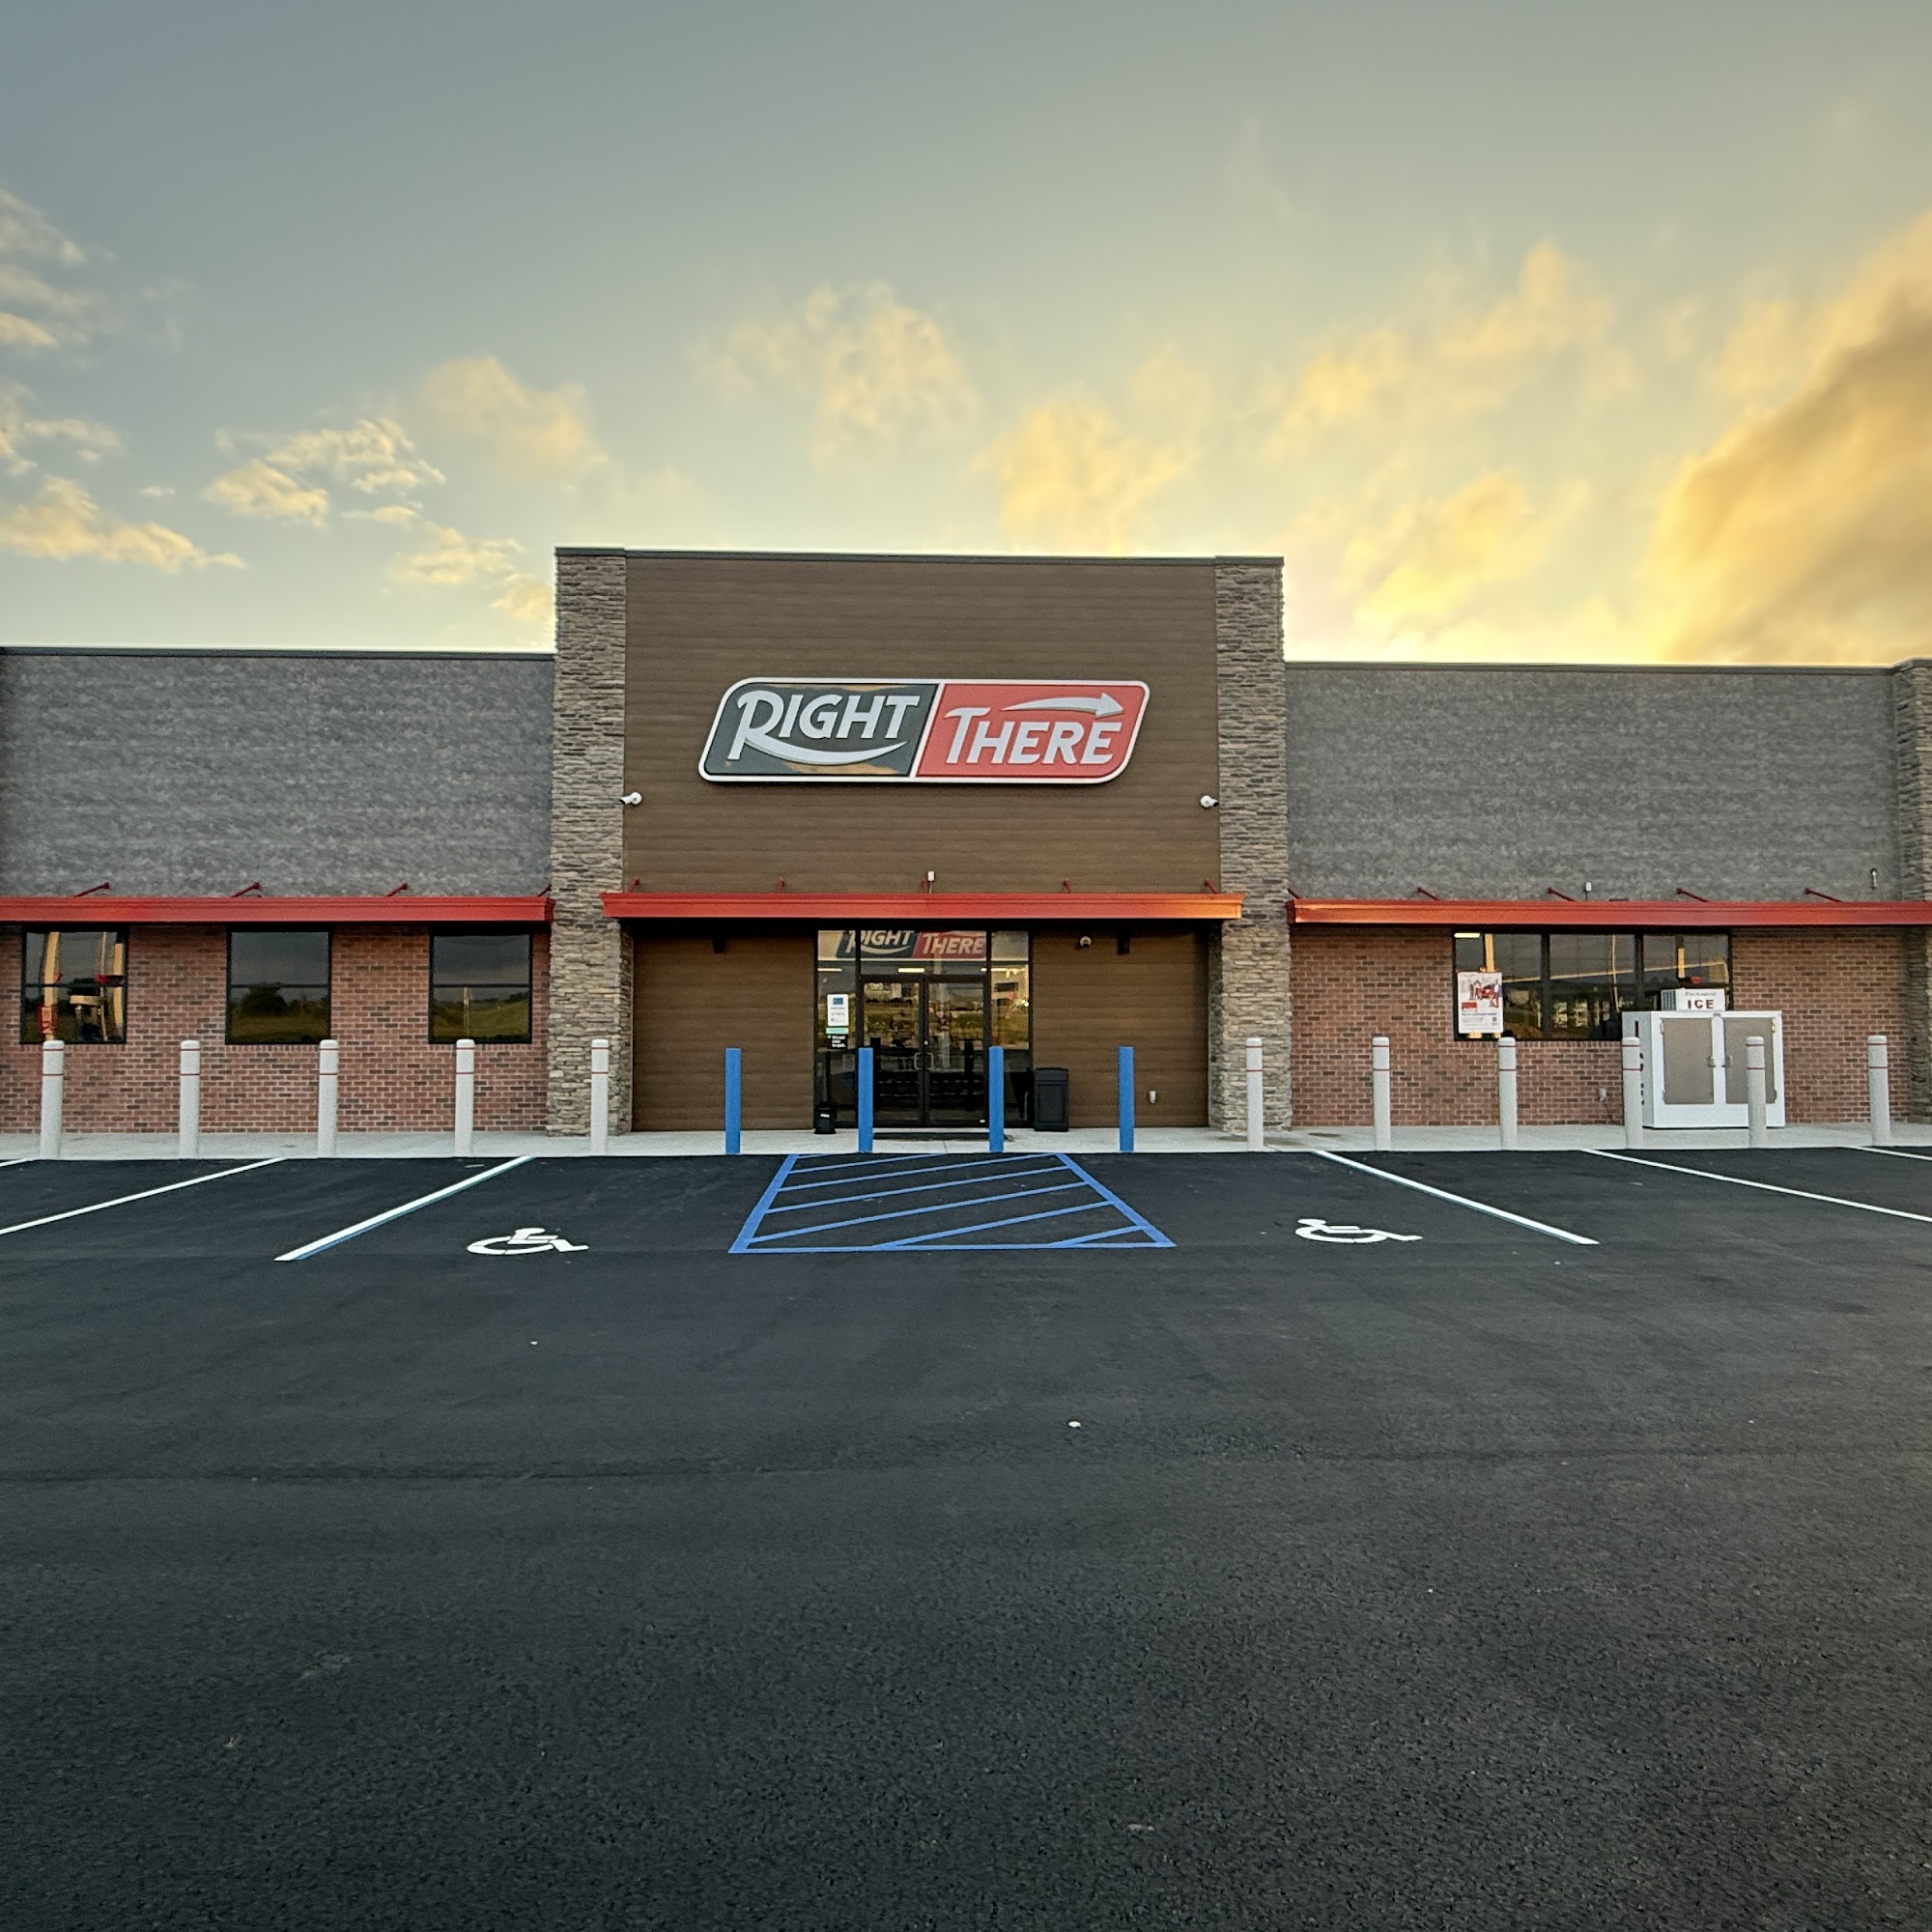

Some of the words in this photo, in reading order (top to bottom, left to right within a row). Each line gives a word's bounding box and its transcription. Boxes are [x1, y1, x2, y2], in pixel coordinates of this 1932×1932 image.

[727, 690, 921, 764] RIGHT
[944, 707, 1122, 764] THERE
[922, 933, 984, 954] THERE
[1688, 999, 1714, 1009] ICE
